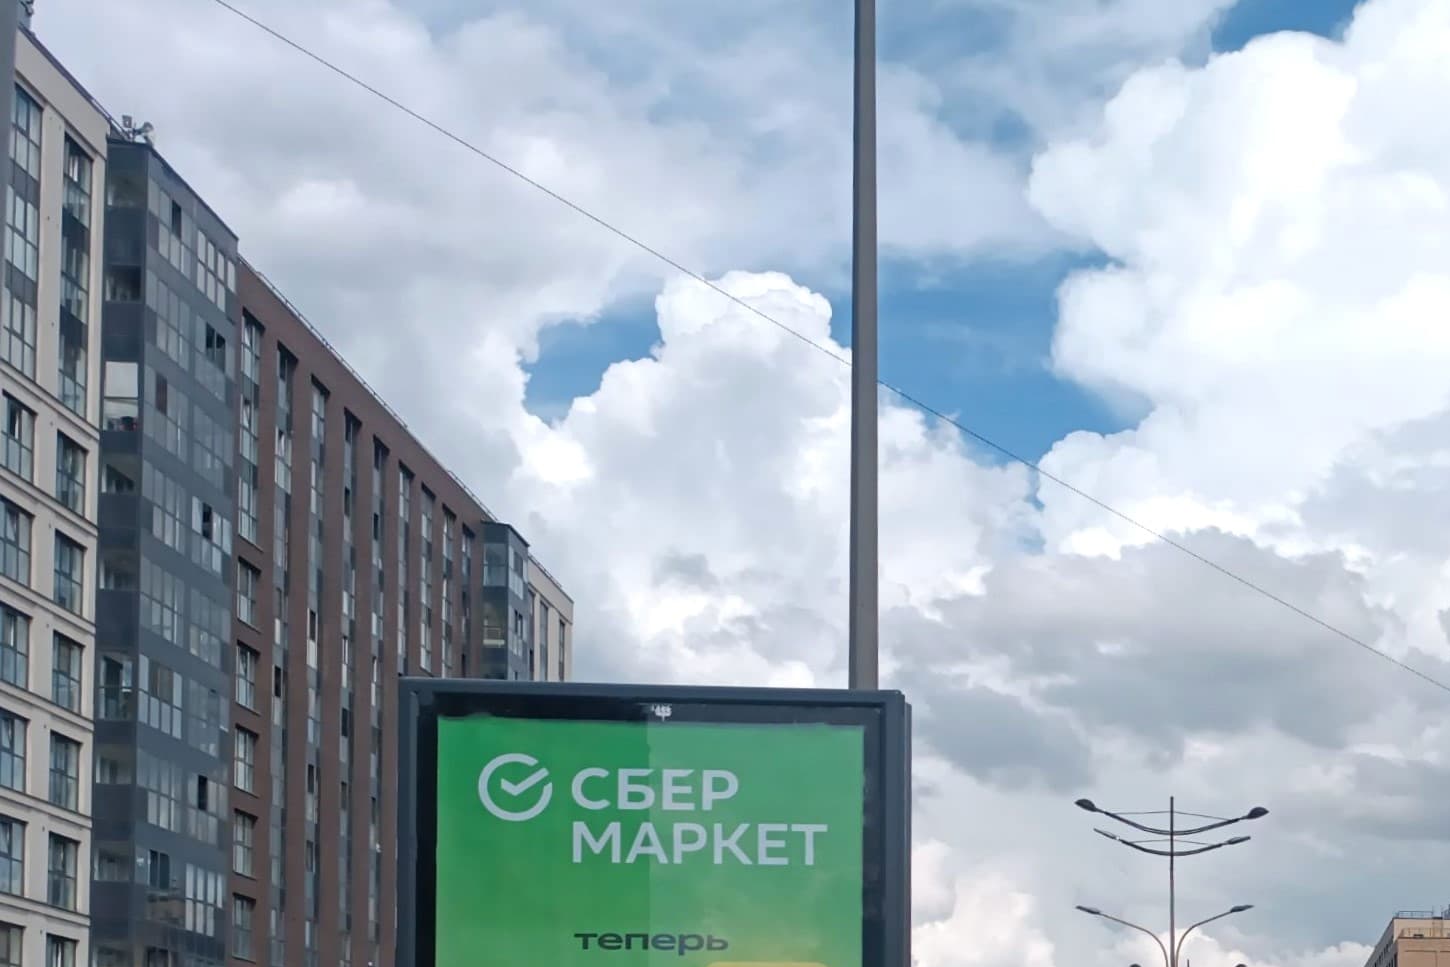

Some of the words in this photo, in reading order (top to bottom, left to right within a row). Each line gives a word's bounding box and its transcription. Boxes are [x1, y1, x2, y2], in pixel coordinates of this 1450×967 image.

[571, 768, 739, 811] СБЕР
[572, 821, 828, 866] МАРКЕТ
[573, 932, 728, 955] теперь
